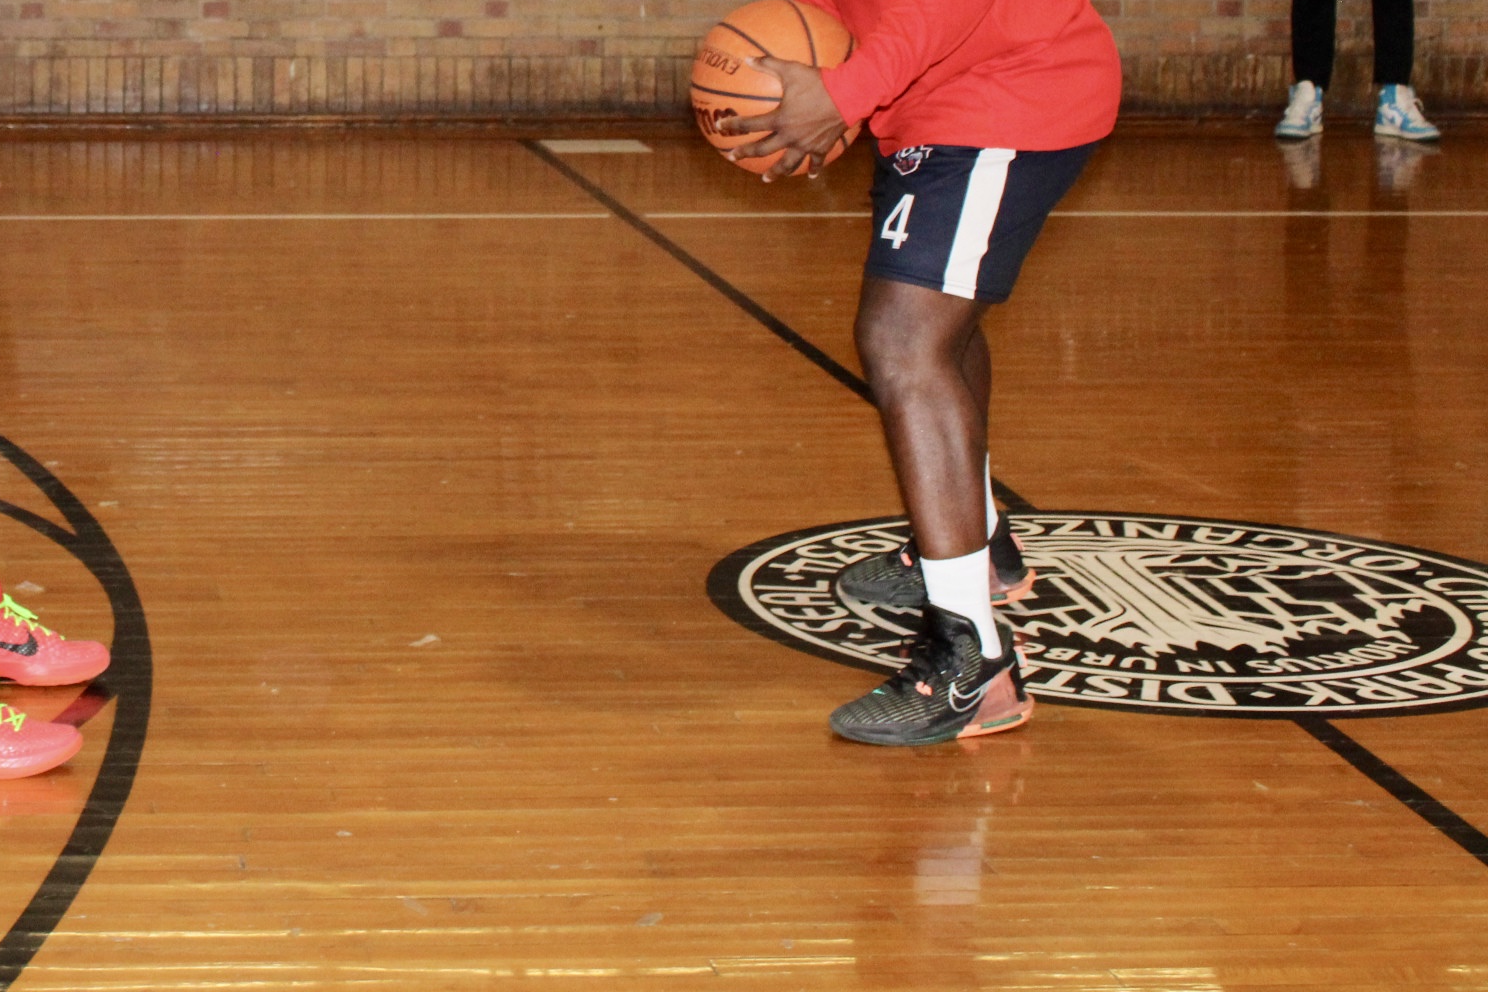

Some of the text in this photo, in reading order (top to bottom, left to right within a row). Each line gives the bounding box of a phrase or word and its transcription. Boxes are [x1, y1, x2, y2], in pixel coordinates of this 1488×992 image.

[880, 193, 916, 250] 4
[768, 519, 1422, 574] ORGANIZE 1934
[753, 580, 874, 633] SEAL
[1174, 659, 1237, 675] IN
[1245, 637, 1420, 675] HORTUS
[1262, 662, 1488, 707] PARK
